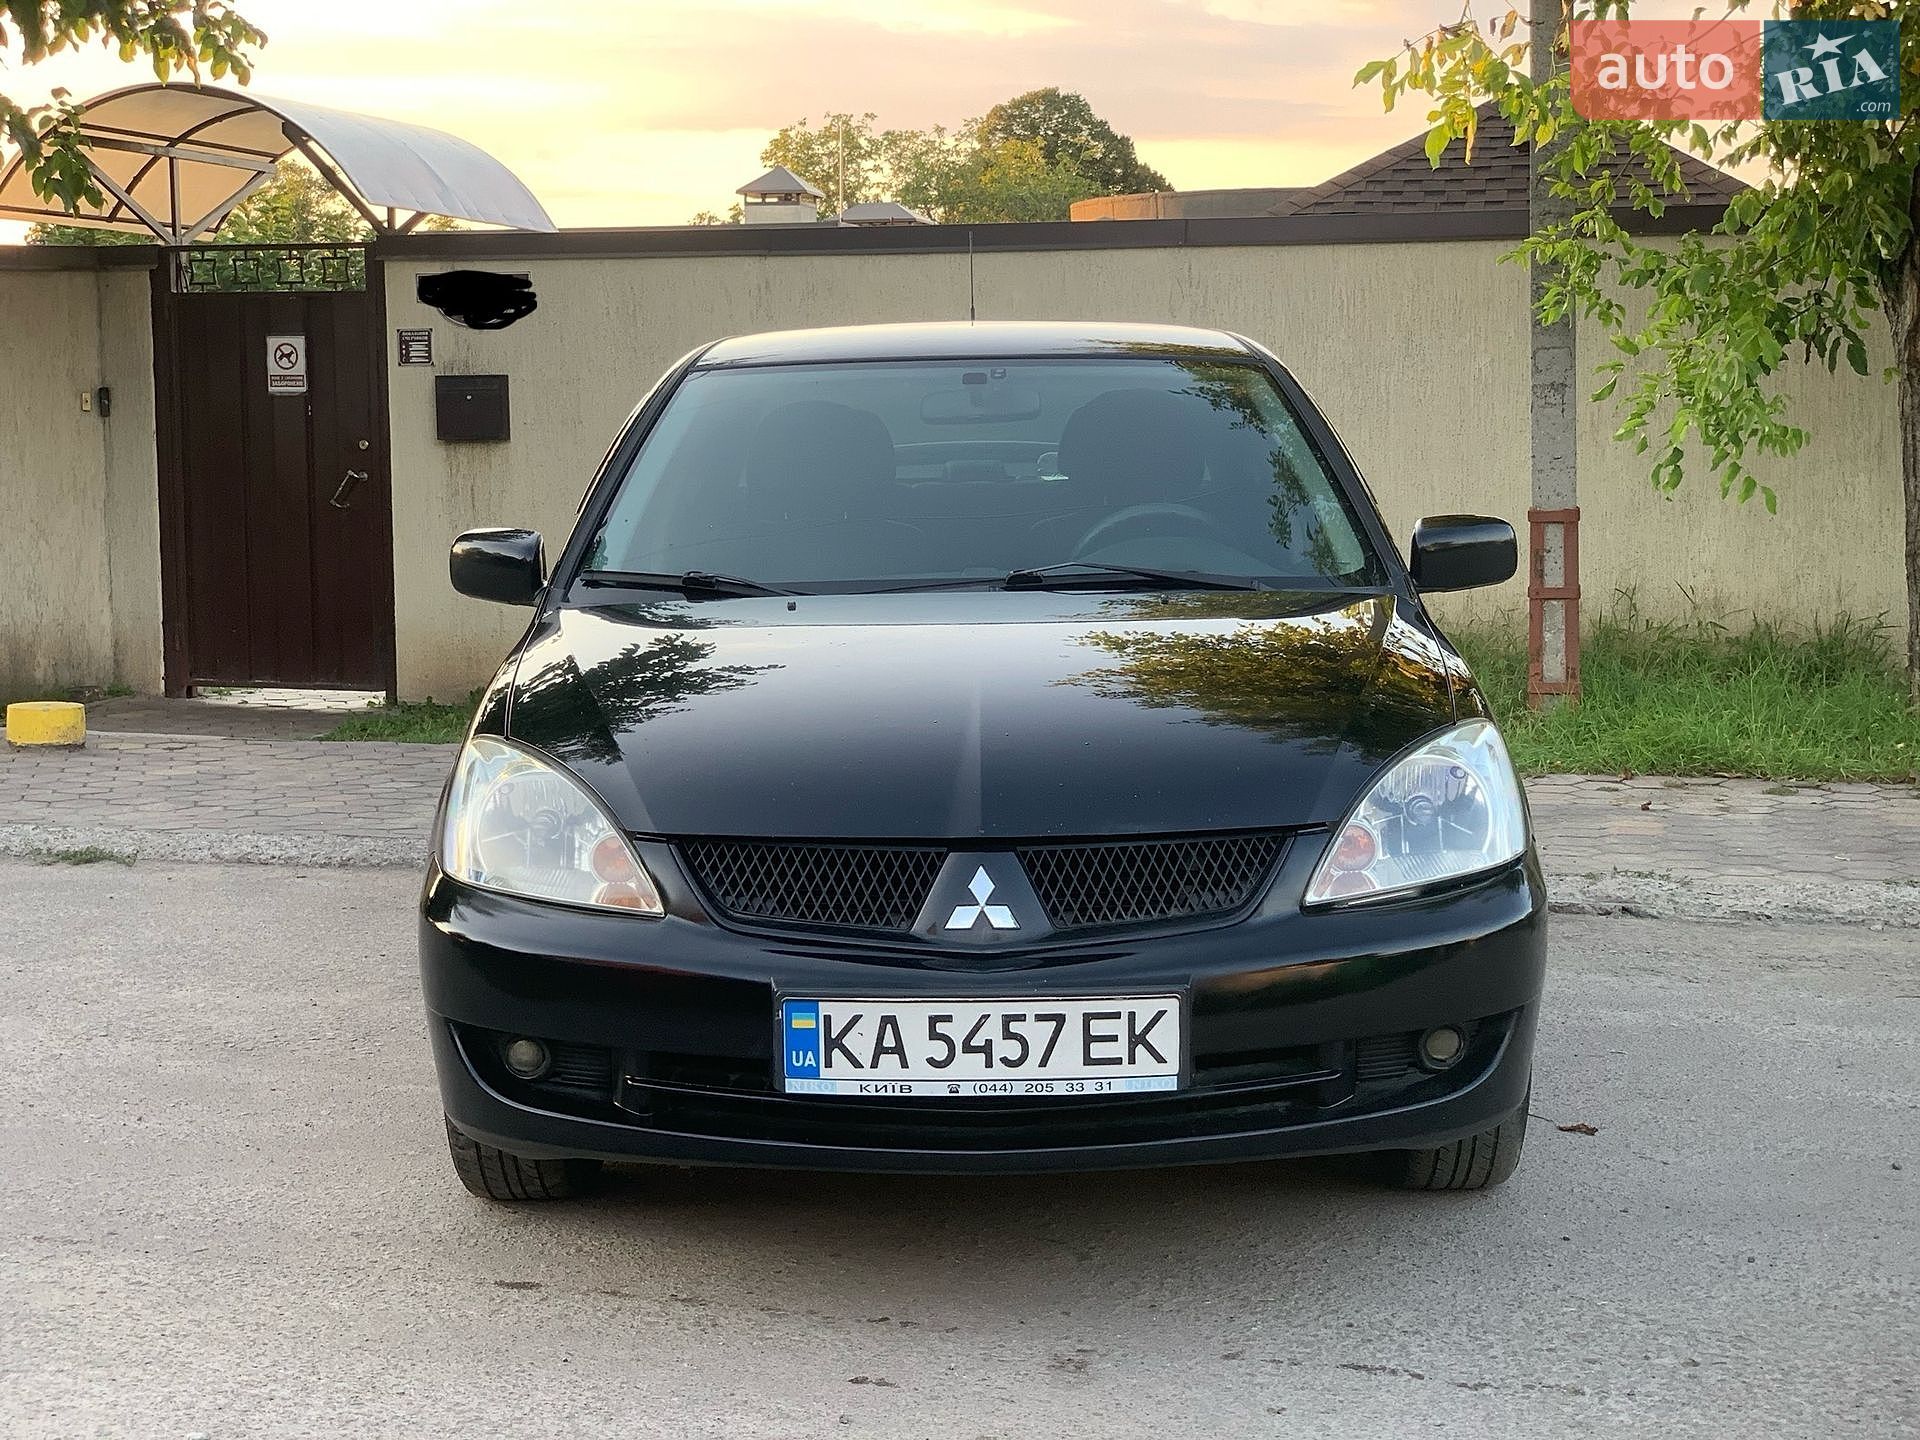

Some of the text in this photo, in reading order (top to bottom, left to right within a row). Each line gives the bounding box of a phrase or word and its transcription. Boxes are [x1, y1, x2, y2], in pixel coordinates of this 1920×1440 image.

[823, 1009, 1168, 1069] KA 5457 EK
[792, 1050, 816, 1067] UA
[973, 1082, 1014, 1095] (044)
[1024, 1083, 1054, 1093] 205
[1065, 1082, 1085, 1092] 33
[1094, 1080, 1113, 1091] 31
